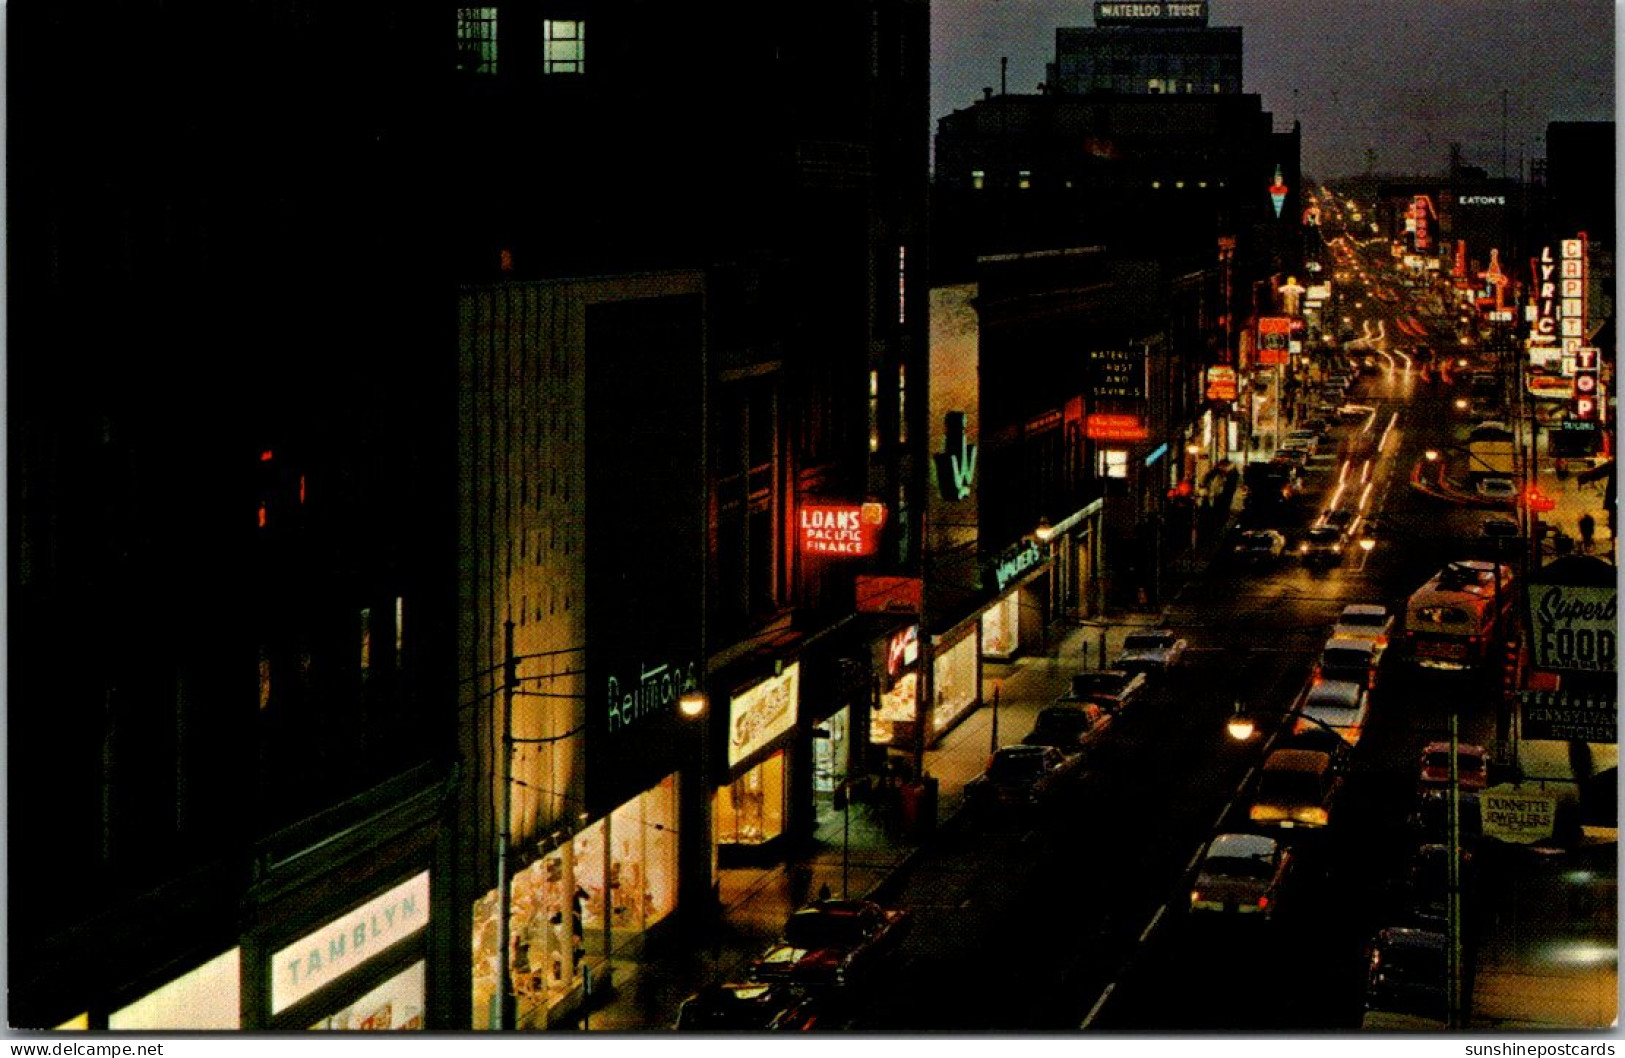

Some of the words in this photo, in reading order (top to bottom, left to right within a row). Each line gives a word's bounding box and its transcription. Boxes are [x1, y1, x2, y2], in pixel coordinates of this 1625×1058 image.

[1101, 4, 1161, 17] WATERLOO
[1167, 4, 1202, 17] TRUST
[1459, 195, 1506, 205] EATON'S
[1538, 246, 1557, 333] LYRIC
[1563, 241, 1582, 375] CAPITOL
[1090, 350, 1144, 360] WATERL
[1578, 352, 1595, 414] TOP
[1093, 386, 1141, 397] SAVINS
[801, 509, 860, 530] LOANS
[806, 529, 862, 541] PACIFIC
[806, 541, 863, 553] FINANCE
[1539, 586, 1617, 629] Superb
[1541, 629, 1616, 662] FOOD
[1551, 725, 1616, 740] KITCHEN
[1487, 798, 1550, 813] DUNNETTE
[1484, 811, 1551, 826] JEWELLERS
[287, 895, 417, 984] TAMBLYN
